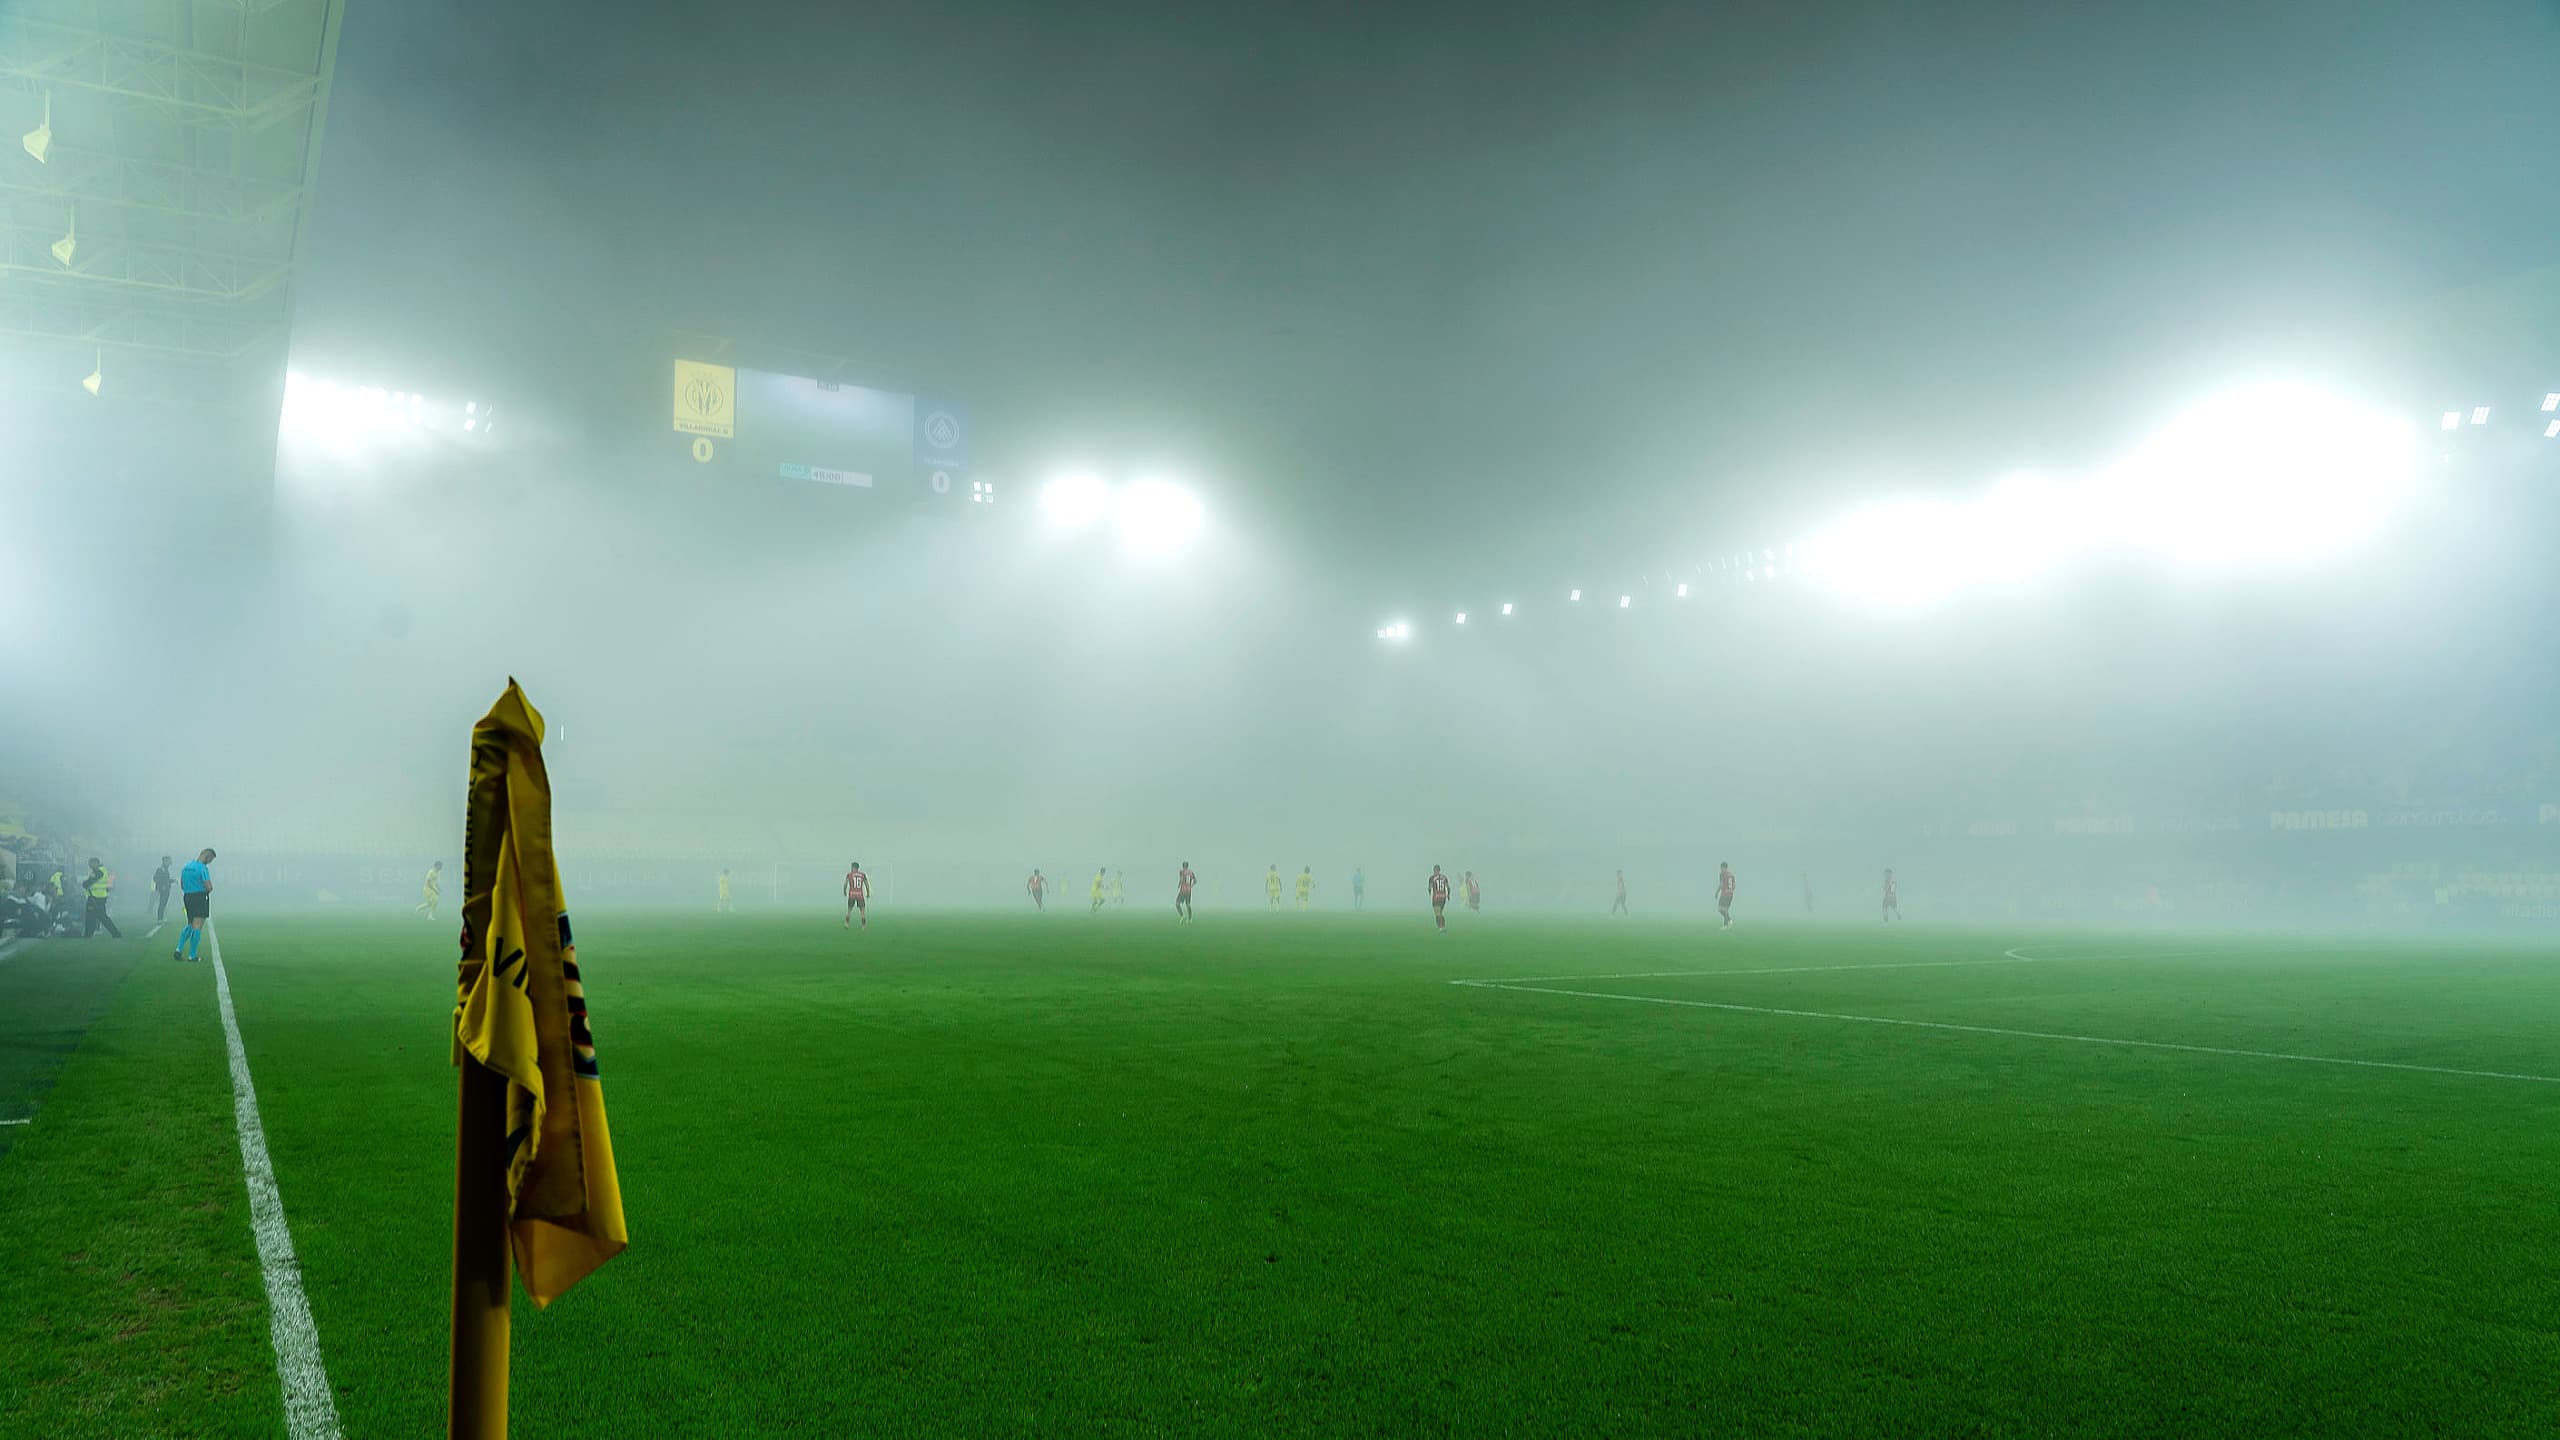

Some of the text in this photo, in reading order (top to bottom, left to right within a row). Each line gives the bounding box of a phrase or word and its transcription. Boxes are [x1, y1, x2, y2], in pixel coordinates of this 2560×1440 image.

[692, 437, 714, 462] 0
[932, 470, 950, 494] 0
[2270, 809, 2369, 830] PAMESA
